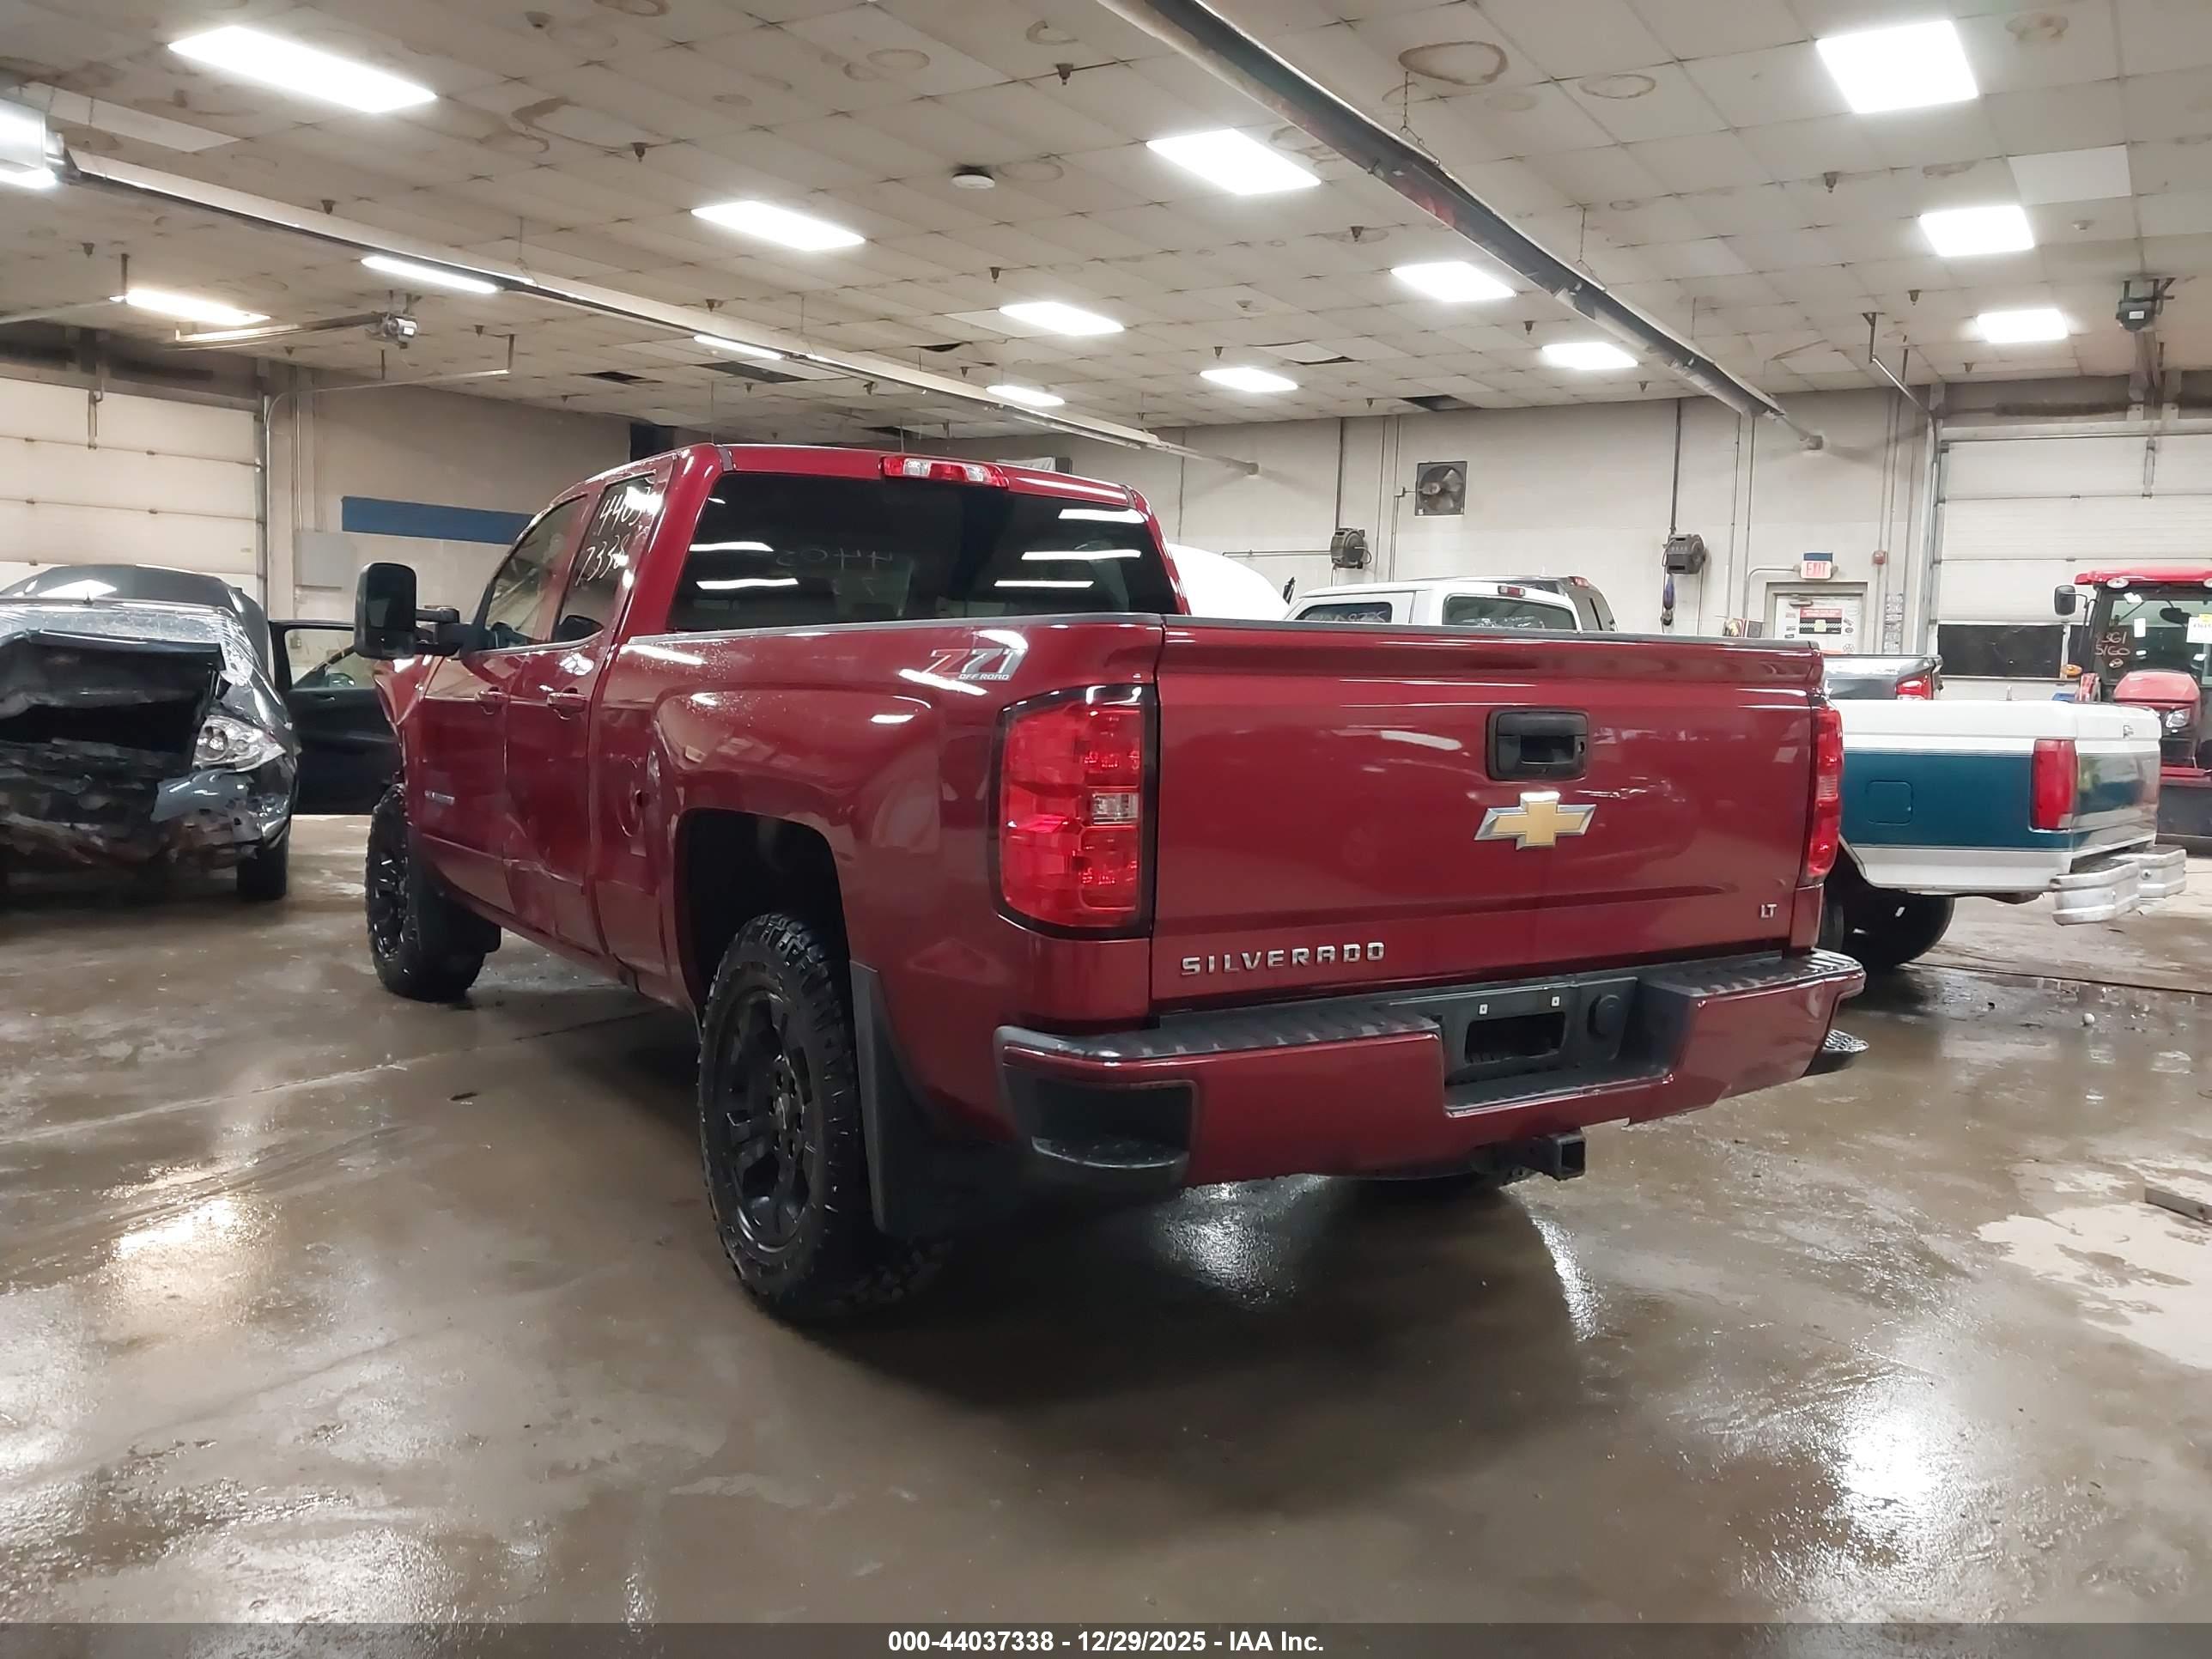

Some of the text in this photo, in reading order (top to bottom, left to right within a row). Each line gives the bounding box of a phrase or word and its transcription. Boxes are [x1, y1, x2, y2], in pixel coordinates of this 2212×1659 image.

[1806, 561, 1828, 577] EXIT
[921, 648, 1028, 680] Z71
[1760, 903, 1778, 919] LT
[1180, 941, 1386, 976] SILVERADO
